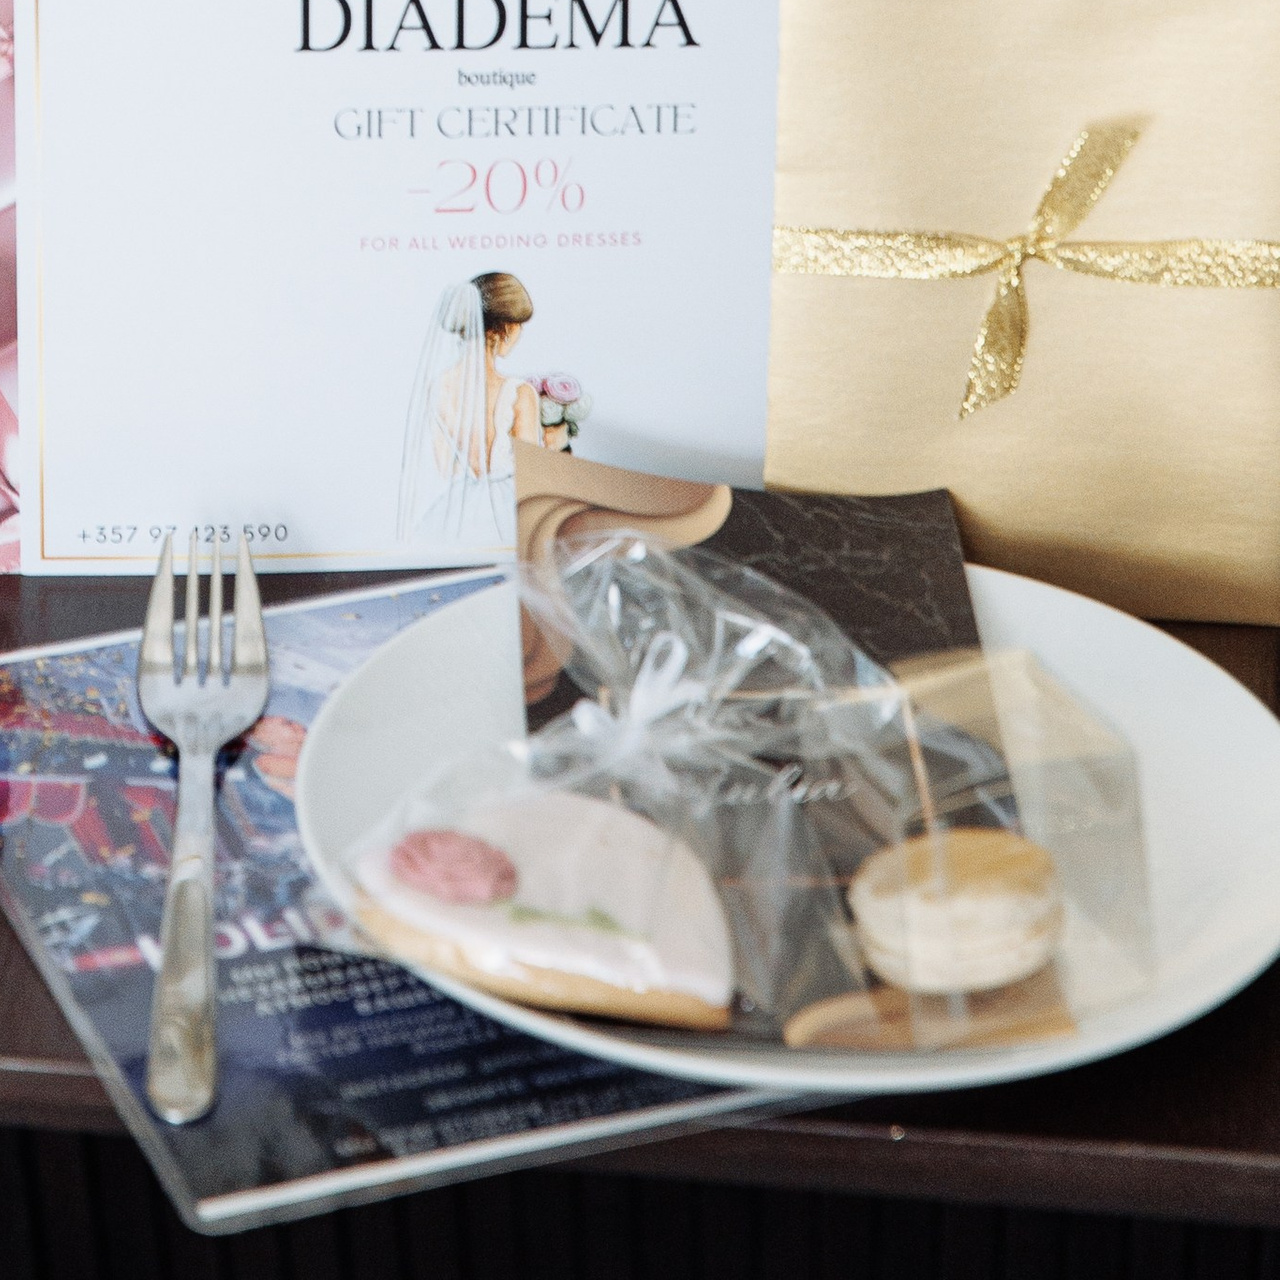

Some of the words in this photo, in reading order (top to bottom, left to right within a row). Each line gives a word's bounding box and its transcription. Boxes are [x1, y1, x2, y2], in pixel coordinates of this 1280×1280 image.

[457, 68, 537, 91] boutique
[334, 106, 423, 141] GIFT
[436, 102, 698, 140] CERTIFICATE
[406, 156, 586, 215] -20%
[360, 236, 400, 252] FOR
[408, 235, 440, 251] ALL
[448, 232, 549, 250] WEDDING
[557, 230, 643, 247] DRESSES
[77, 524, 138, 545] +357
[148, 524, 178, 544] 97
[243, 522, 290, 543] 590
